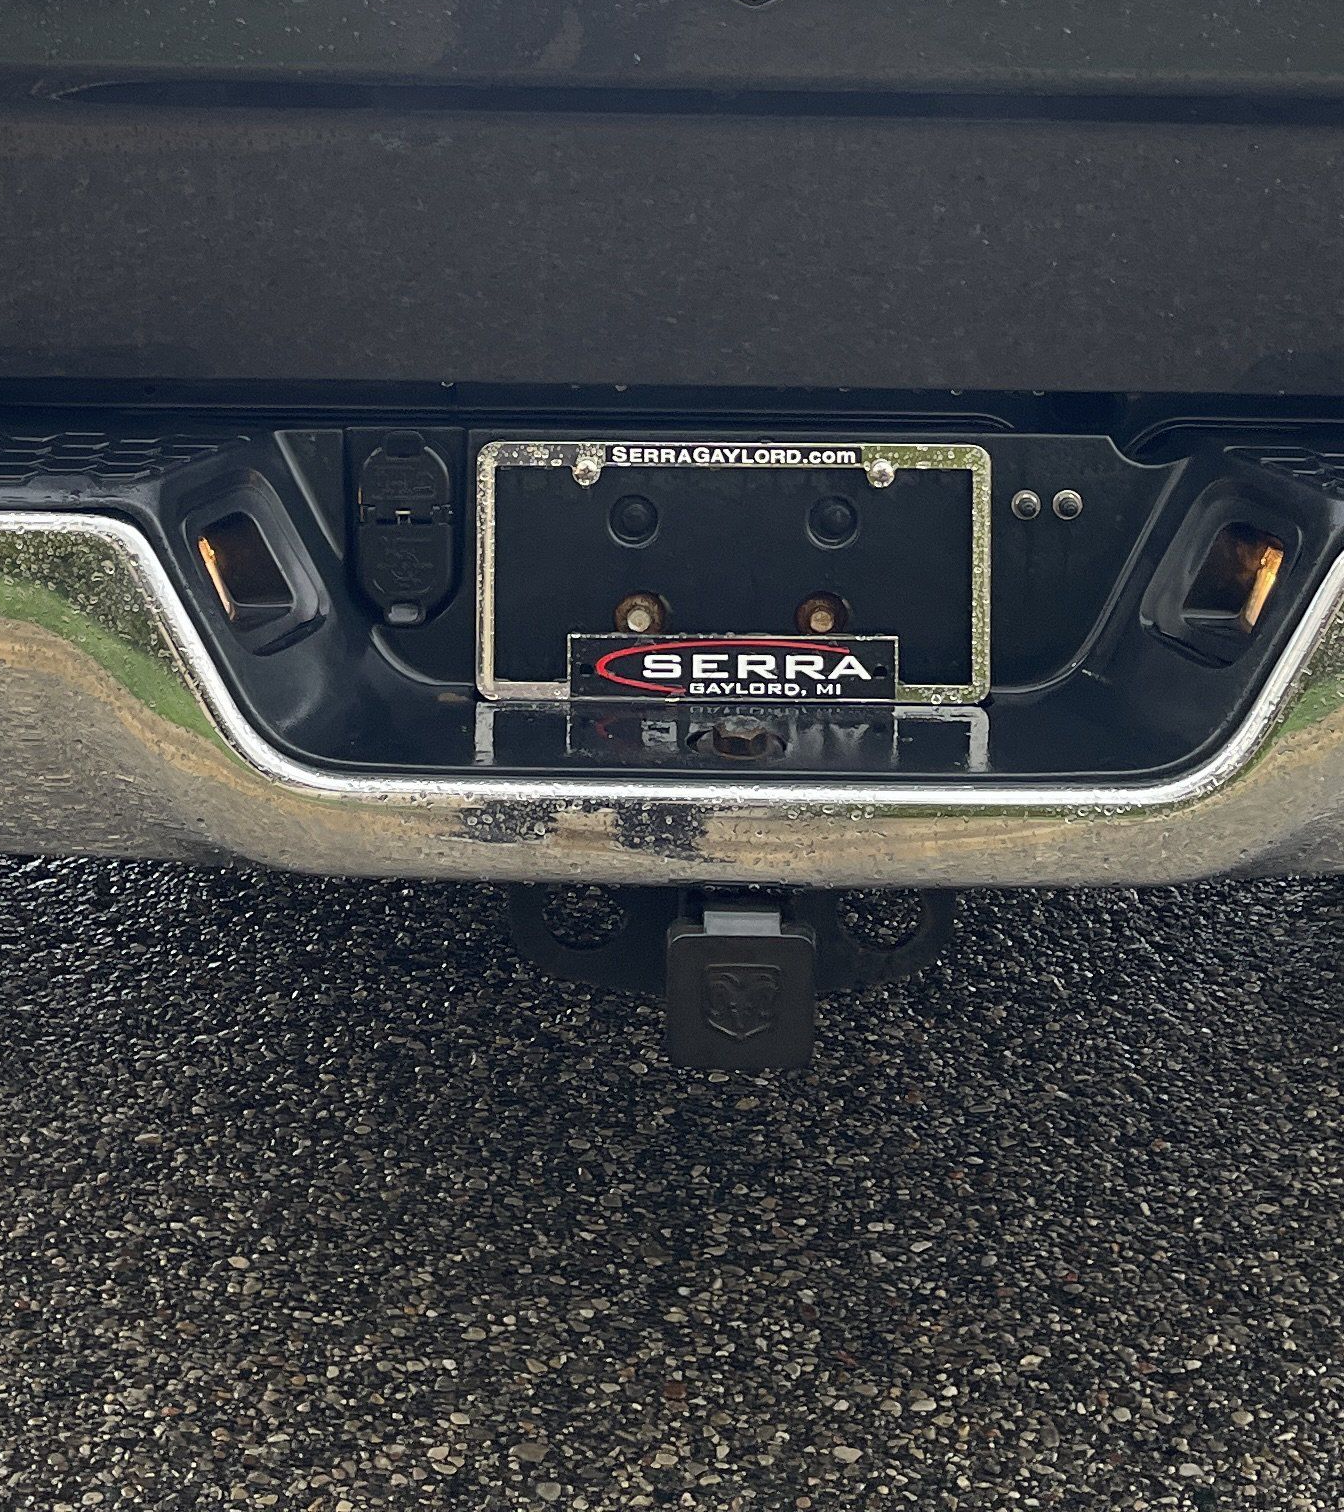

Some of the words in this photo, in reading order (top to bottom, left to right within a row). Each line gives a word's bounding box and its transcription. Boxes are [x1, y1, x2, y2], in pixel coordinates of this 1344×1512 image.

[642, 654, 872, 680] SERRA
[689, 682, 807, 696] GAYLORD,
[817, 683, 841, 695] MI
